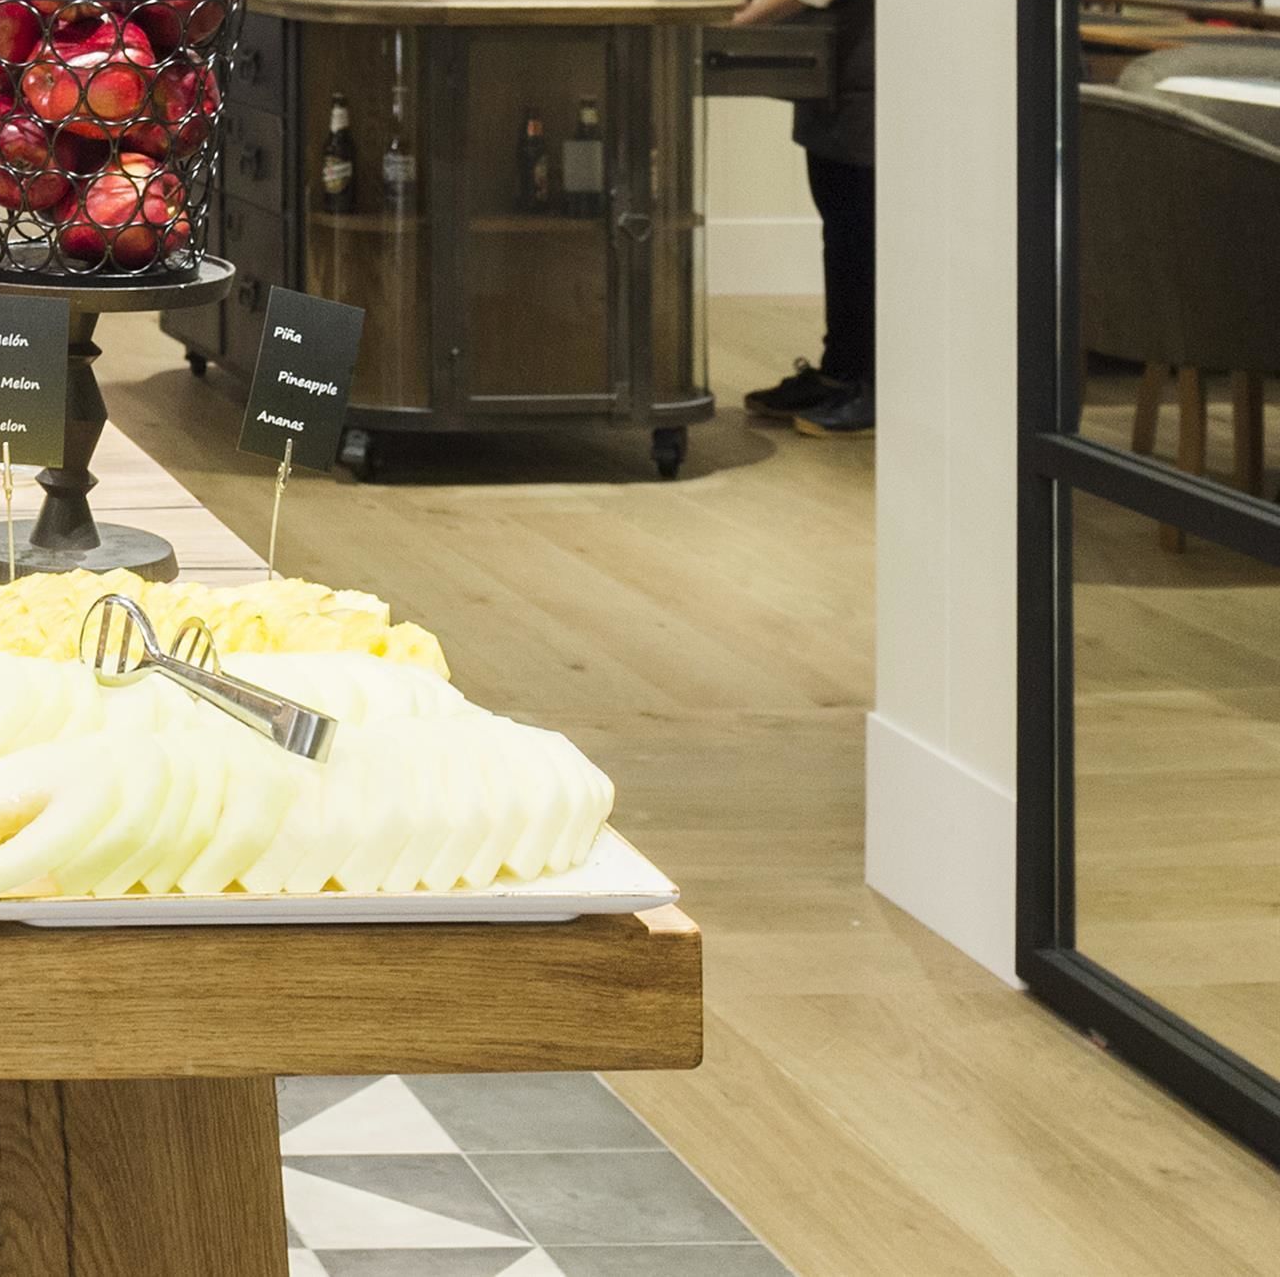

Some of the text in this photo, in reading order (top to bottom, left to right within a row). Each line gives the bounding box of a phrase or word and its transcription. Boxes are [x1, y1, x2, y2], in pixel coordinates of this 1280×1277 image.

[273, 326, 302, 344] Piña
[0, 377, 40, 390] Melon
[277, 371, 338, 397] Pineapple
[257, 410, 304, 432] Ananas
